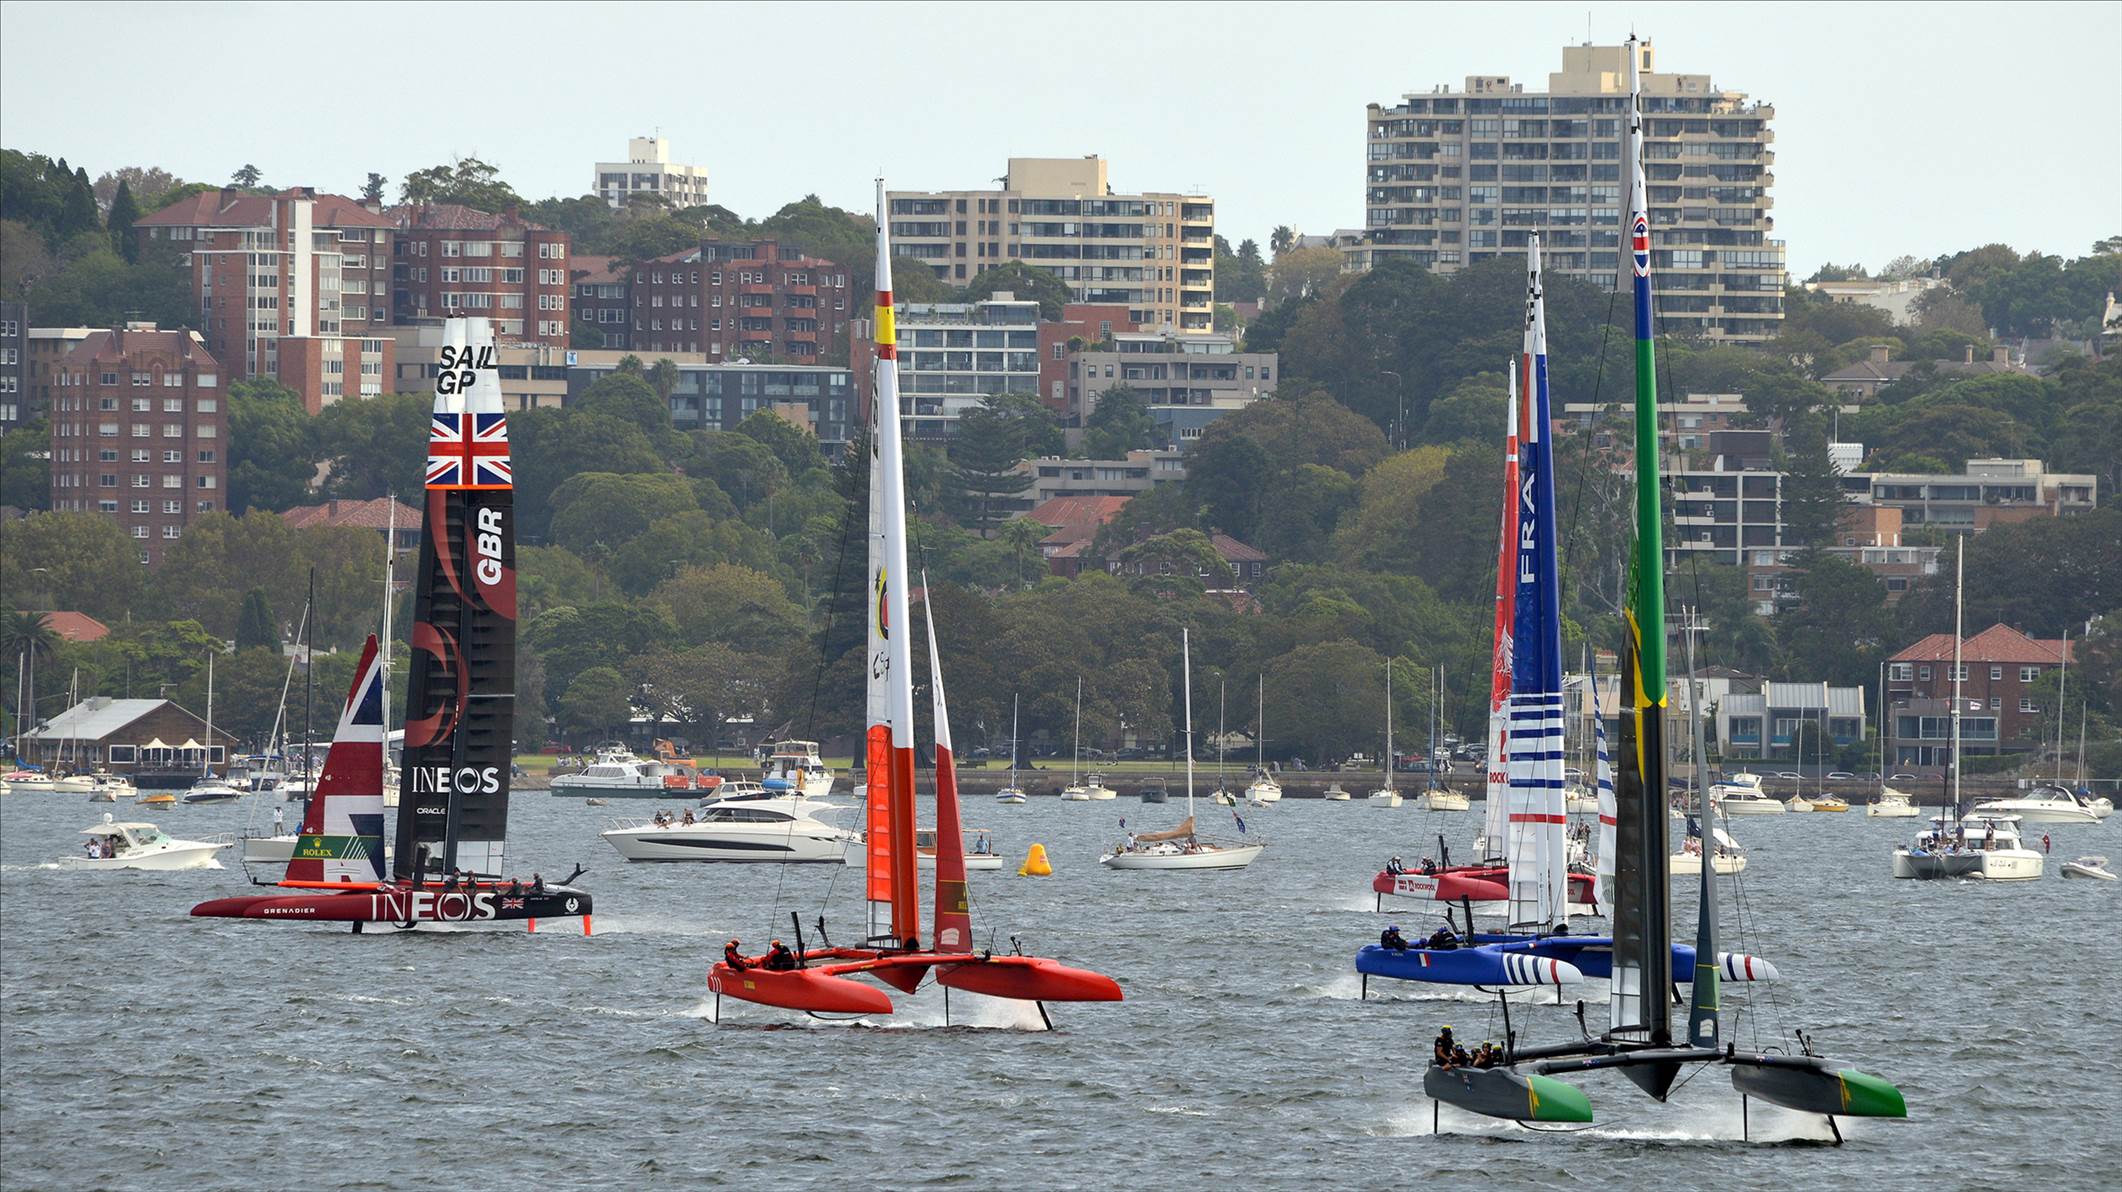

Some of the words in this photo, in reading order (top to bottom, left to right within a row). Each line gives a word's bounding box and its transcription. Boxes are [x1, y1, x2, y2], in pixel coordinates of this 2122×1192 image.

[440, 345, 497, 370] SAIL
[437, 370, 476, 395] GP
[1521, 473, 1535, 584] FRA
[477, 507, 502, 586] GBR
[412, 766, 500, 794] INEOS
[416, 807, 446, 815] ORACLE
[303, 848, 332, 857] ROLEX
[370, 892, 496, 921] INEOS
